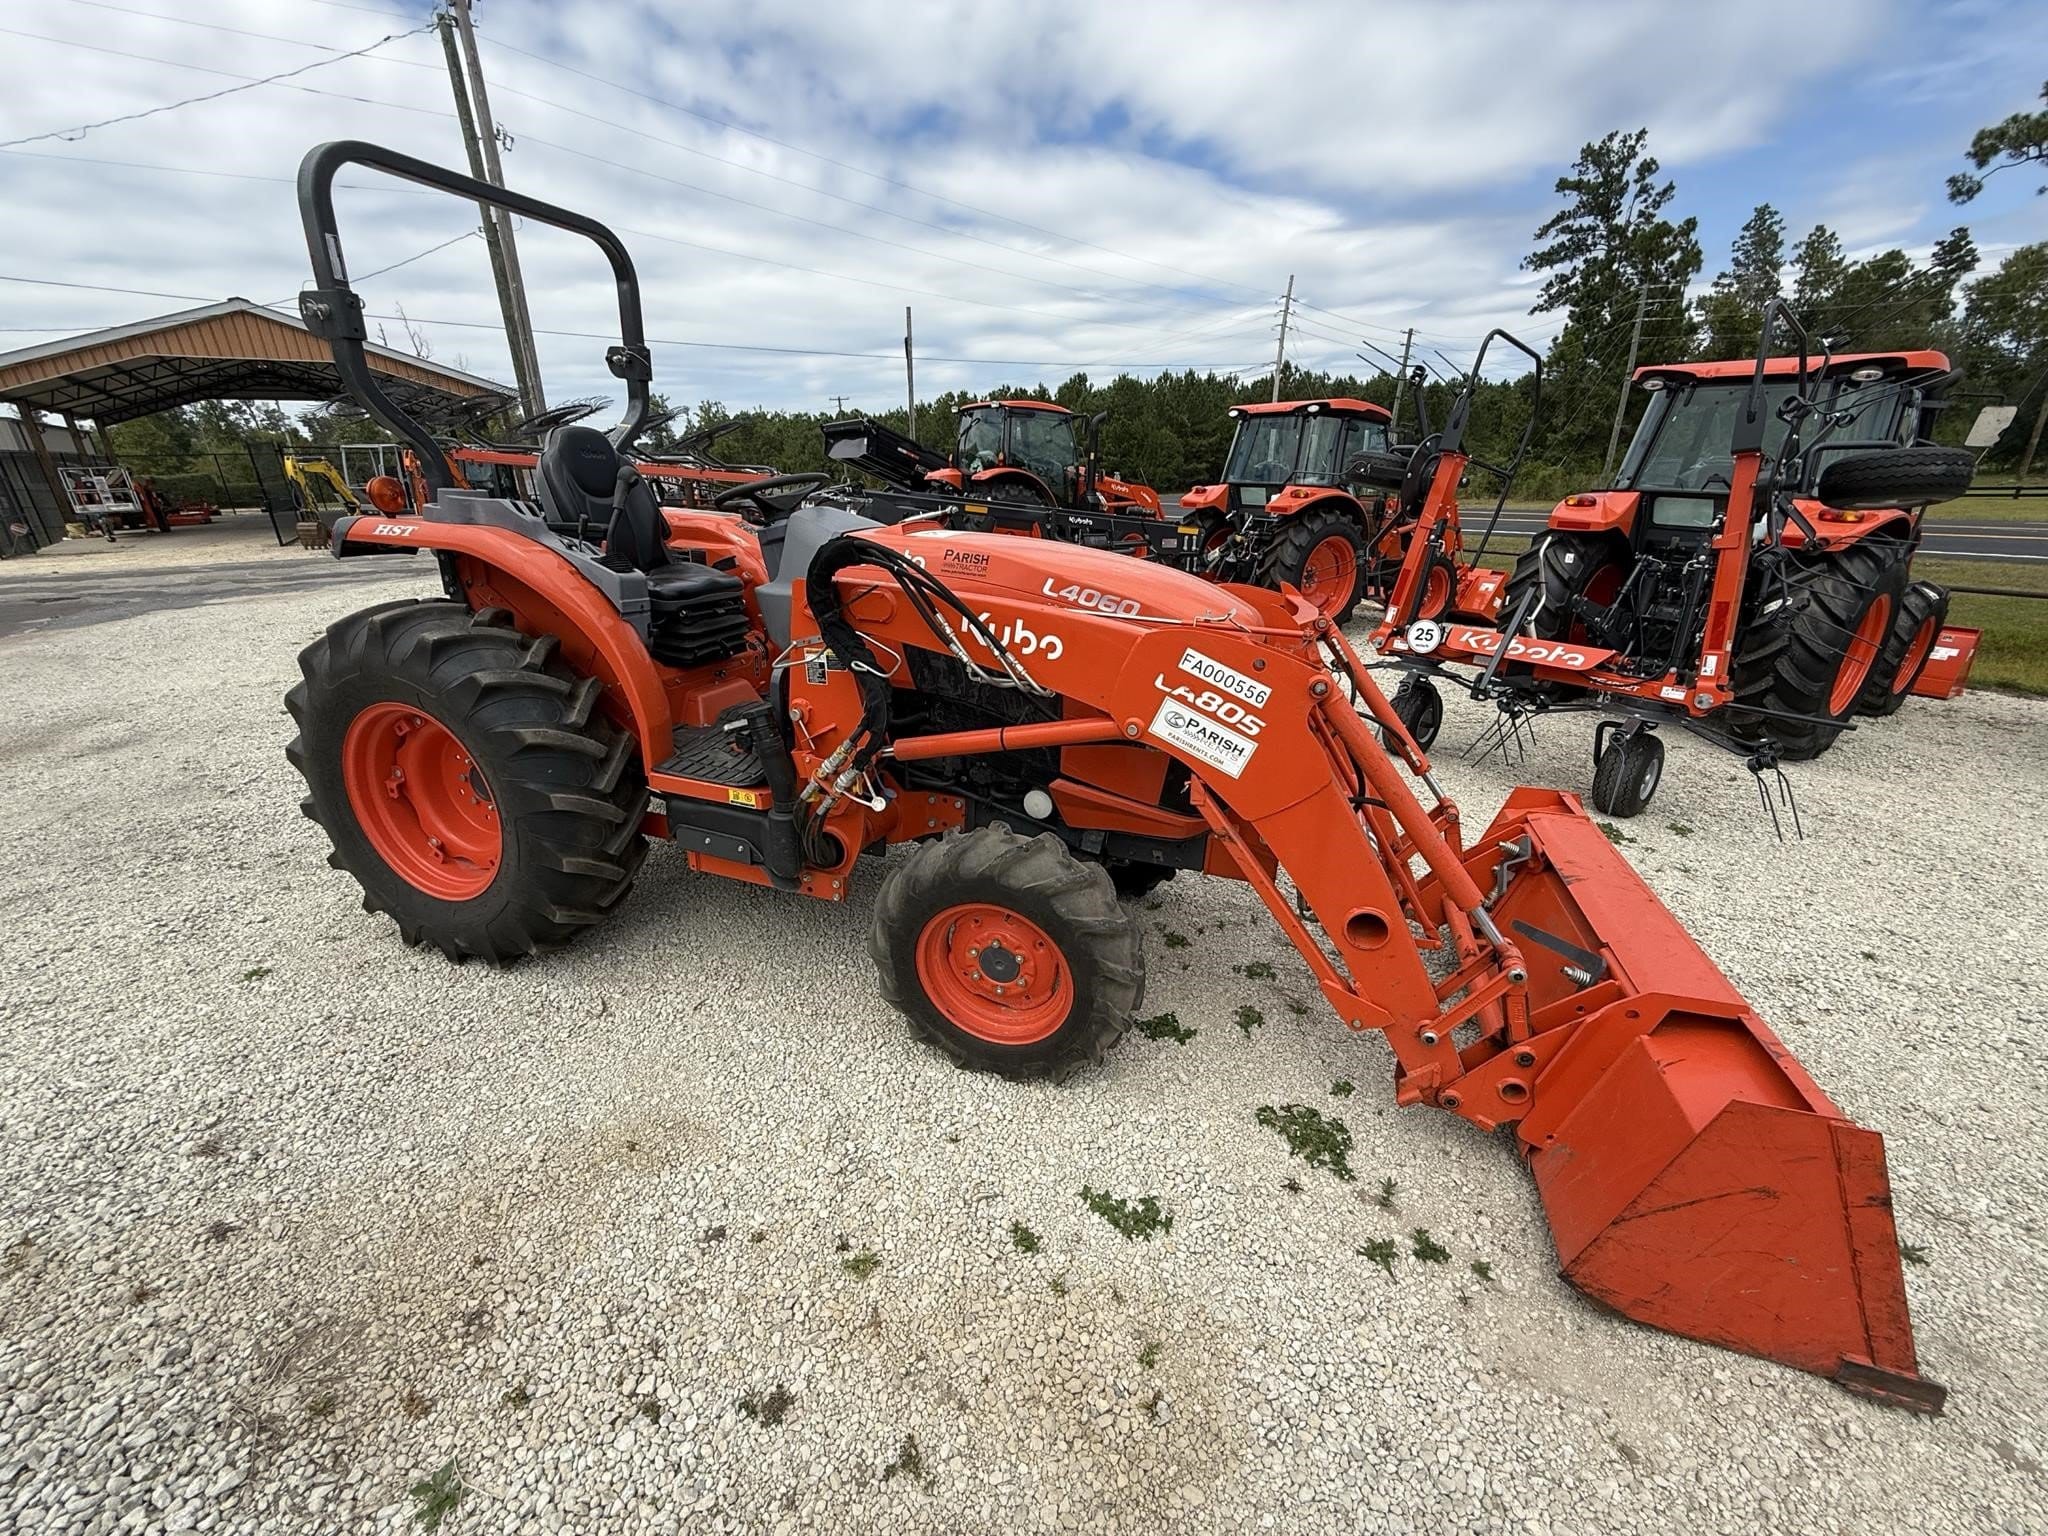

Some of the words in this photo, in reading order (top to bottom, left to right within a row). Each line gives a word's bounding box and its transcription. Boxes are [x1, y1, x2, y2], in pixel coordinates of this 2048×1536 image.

[372, 524, 420, 537] HST
[1068, 515, 1093, 526] Kubota
[943, 549, 990, 566] PARISH
[955, 563, 988, 573] TRACTOR
[1042, 577, 1141, 616] L4060
[1414, 627, 1434, 642] 25
[1459, 631, 1585, 667] Kubota
[1181, 653, 1267, 705] FA000556
[1154, 672, 1267, 737] LA805
[1168, 731, 1225, 766] PARISHRENTS.COM
[1186, 718, 1245, 757] PARISH
